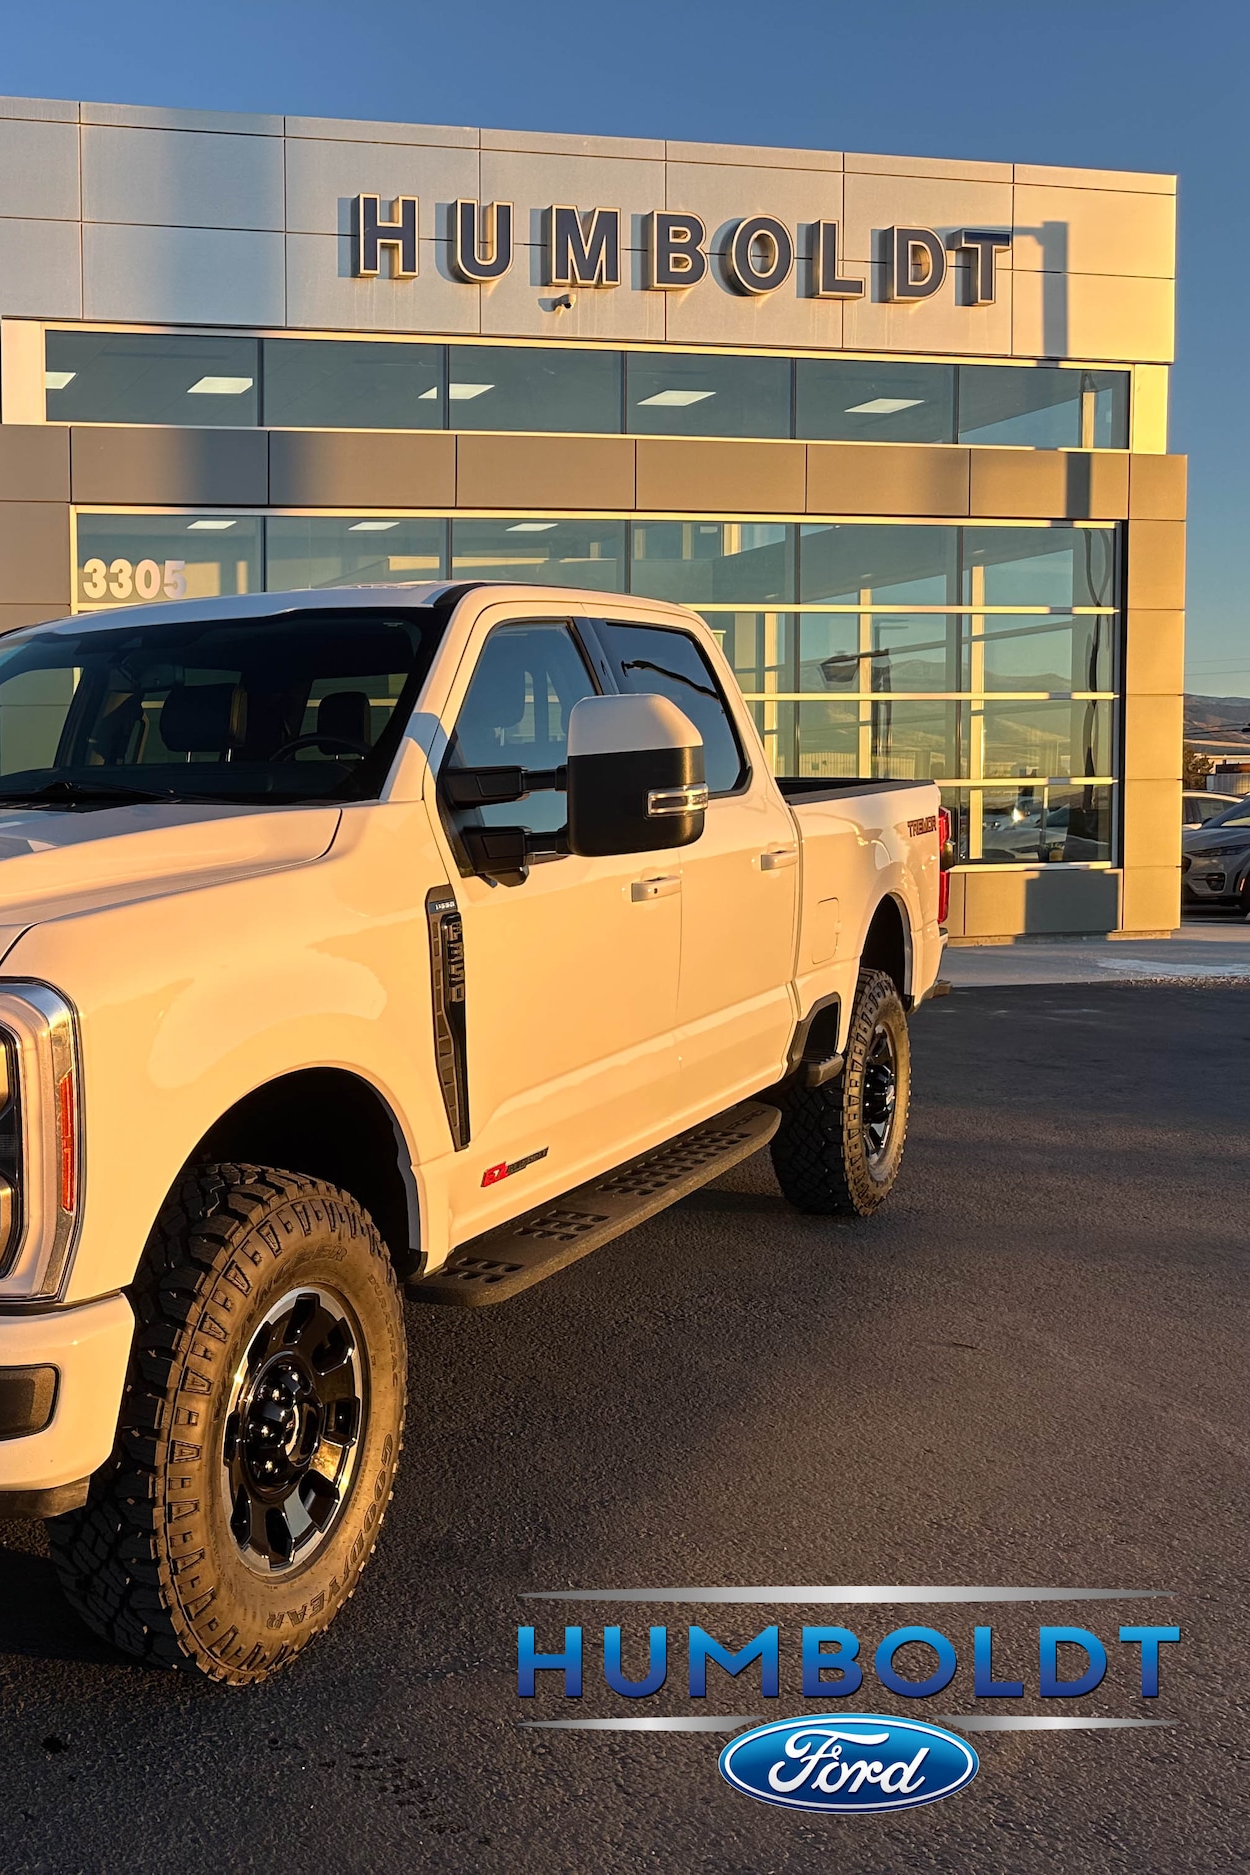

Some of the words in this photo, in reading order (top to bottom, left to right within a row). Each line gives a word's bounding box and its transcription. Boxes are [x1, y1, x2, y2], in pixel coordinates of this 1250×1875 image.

[355, 193, 1012, 307] HUMBOLDT
[82, 558, 187, 599] 3305
[907, 815, 937, 838] TREMOR
[265, 1433, 394, 1631] GOODYEAR
